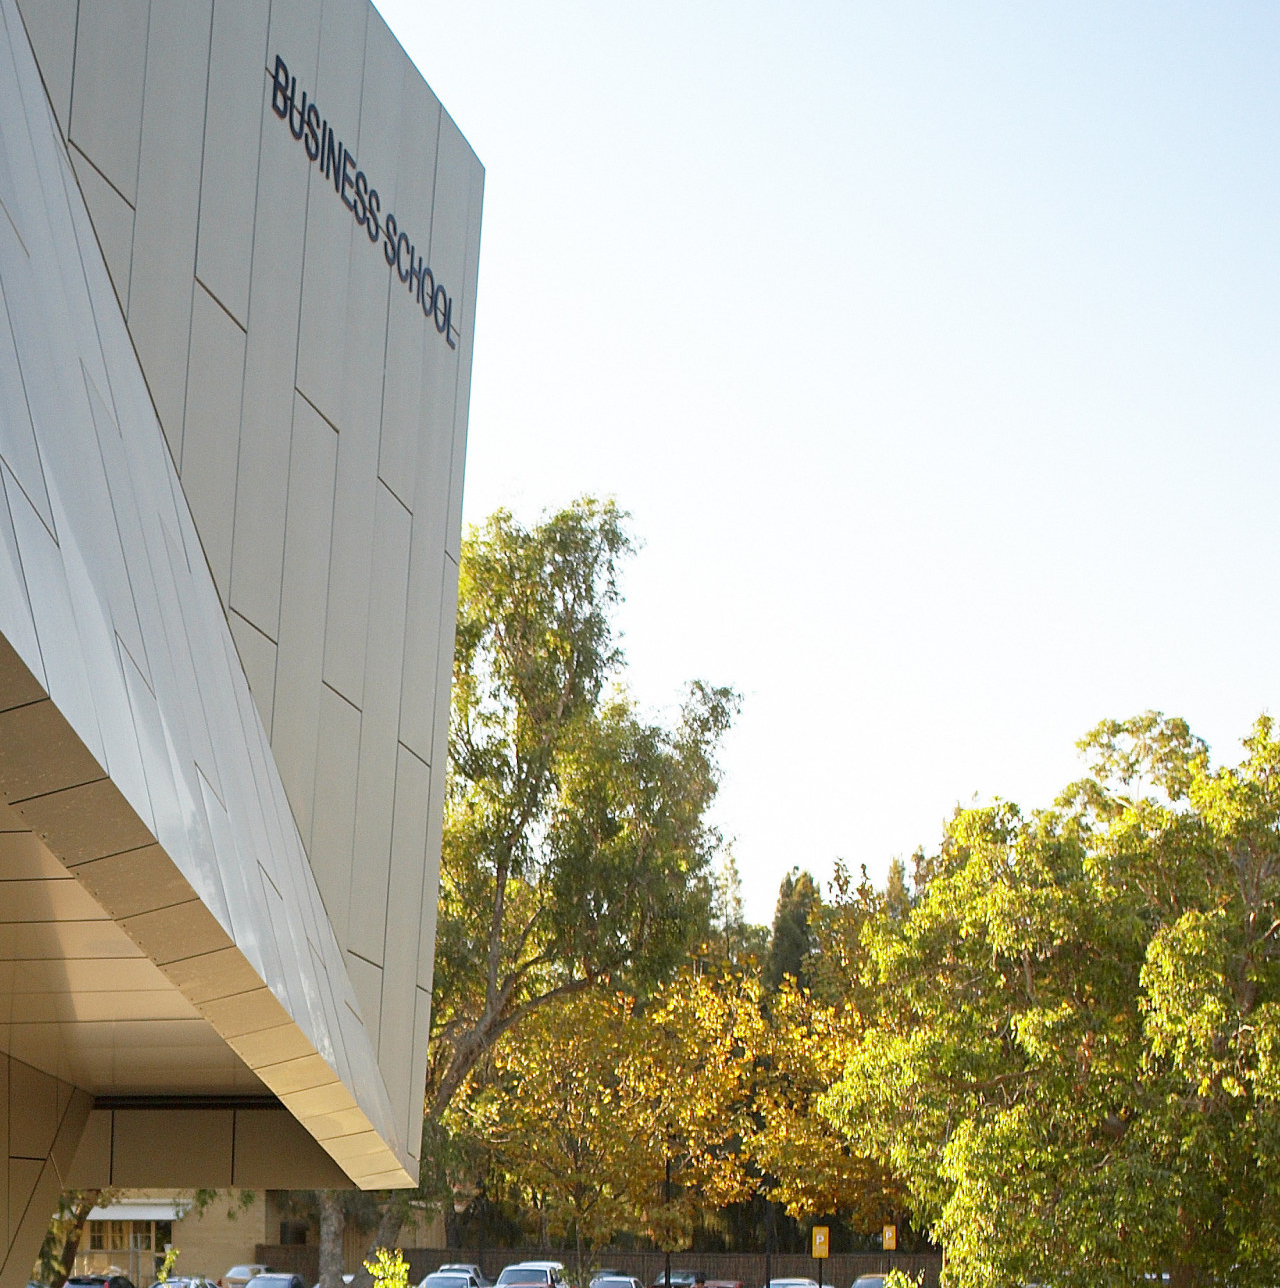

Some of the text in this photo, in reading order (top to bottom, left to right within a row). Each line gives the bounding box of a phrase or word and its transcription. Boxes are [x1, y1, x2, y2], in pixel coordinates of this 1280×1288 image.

[272, 54, 456, 351] BUSINESS SCHOOL
[816, 1234, 825, 1245] P
